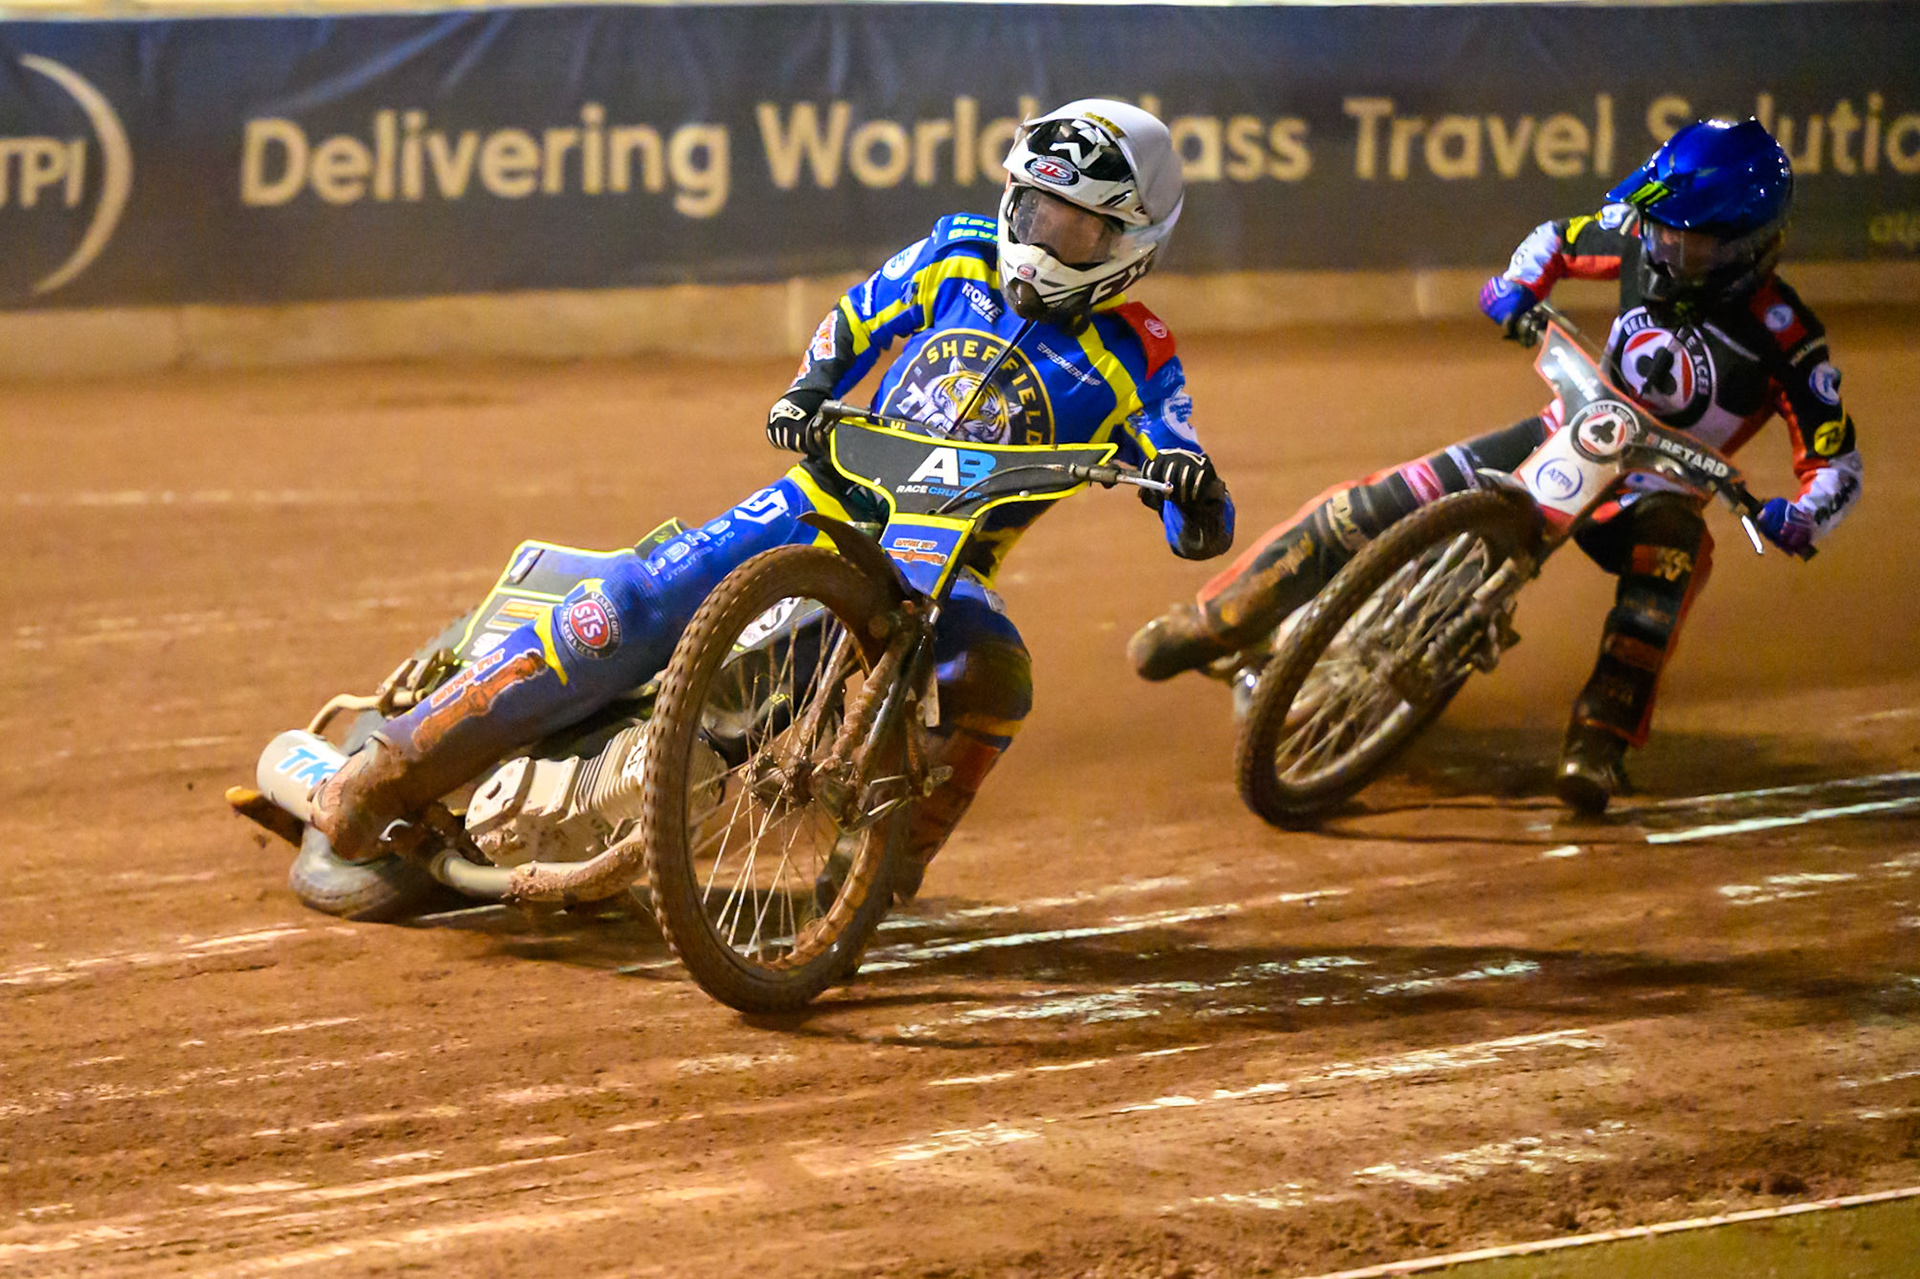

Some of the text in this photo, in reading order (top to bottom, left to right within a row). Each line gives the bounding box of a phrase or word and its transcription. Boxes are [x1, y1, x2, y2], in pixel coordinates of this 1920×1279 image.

[240, 102, 730, 218] Delivering
[1095, 93, 1311, 183] ass
[1343, 93, 1613, 182] Travel
[961, 281, 1004, 321] ROWE
[926, 340, 1044, 445] SHEFFIELD
[908, 446, 997, 488] AB
[896, 484, 929, 495] RACE
[713, 530, 736, 548] LTD
[573, 604, 605, 639] STS
